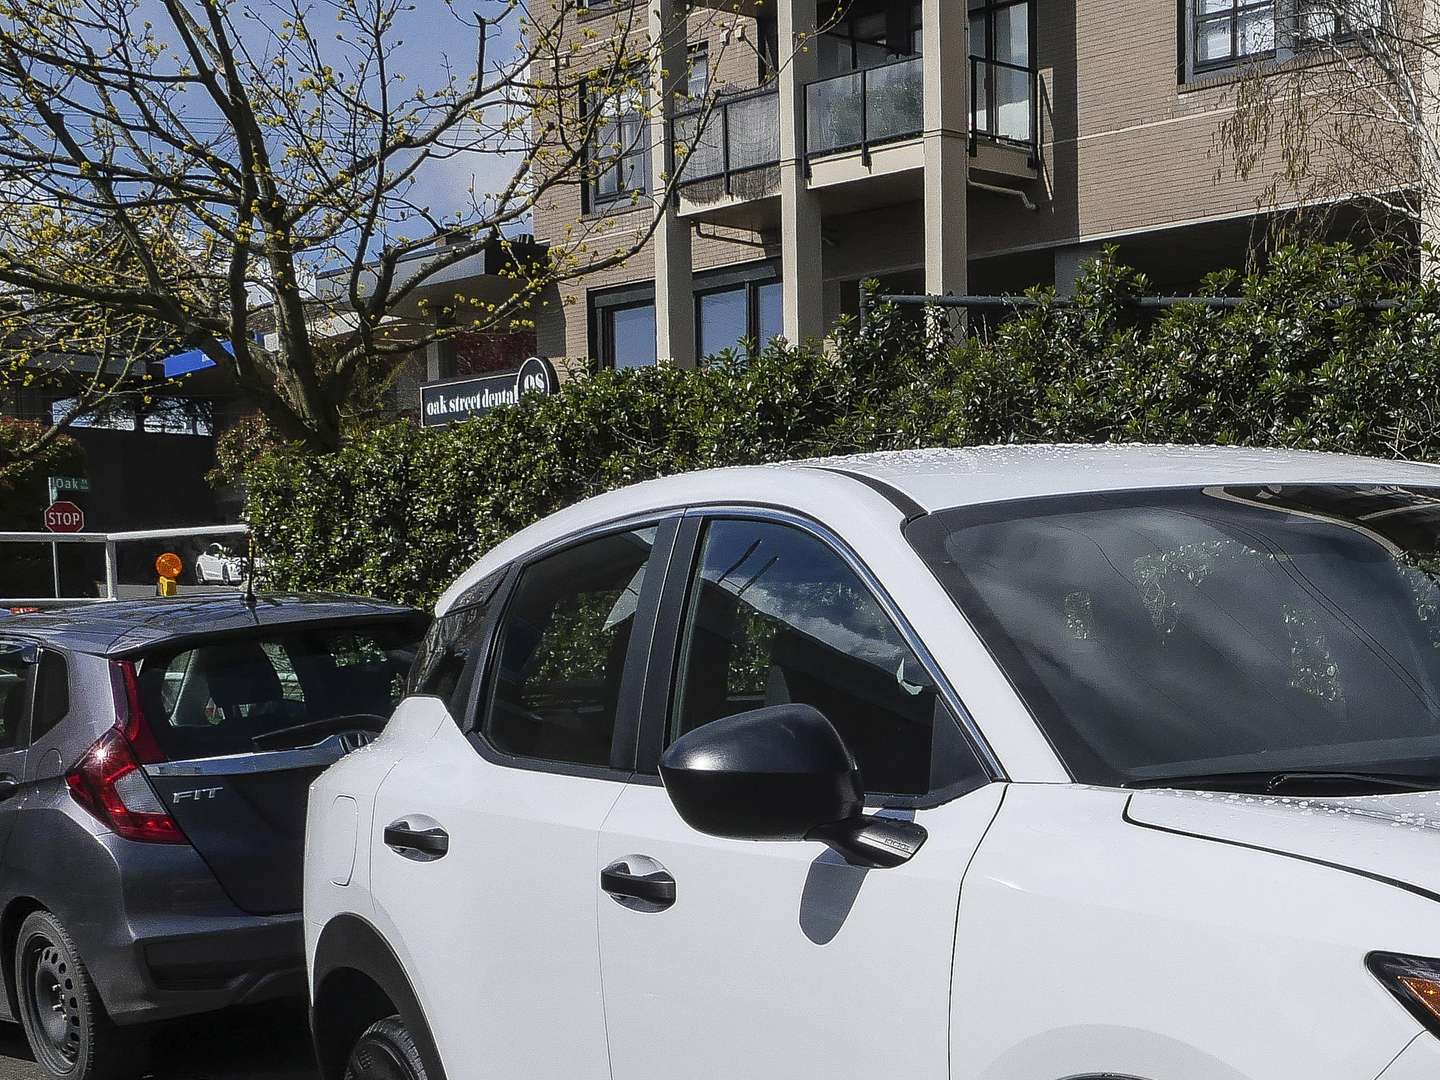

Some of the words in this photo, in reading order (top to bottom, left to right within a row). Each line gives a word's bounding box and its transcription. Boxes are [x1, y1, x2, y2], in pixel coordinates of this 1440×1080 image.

[426, 395, 448, 416] oak
[448, 391, 481, 412] street
[482, 385, 519, 407] dental
[56, 478, 78, 489] Oak
[48, 512, 80, 526] STOP
[173, 786, 224, 804] FIT
